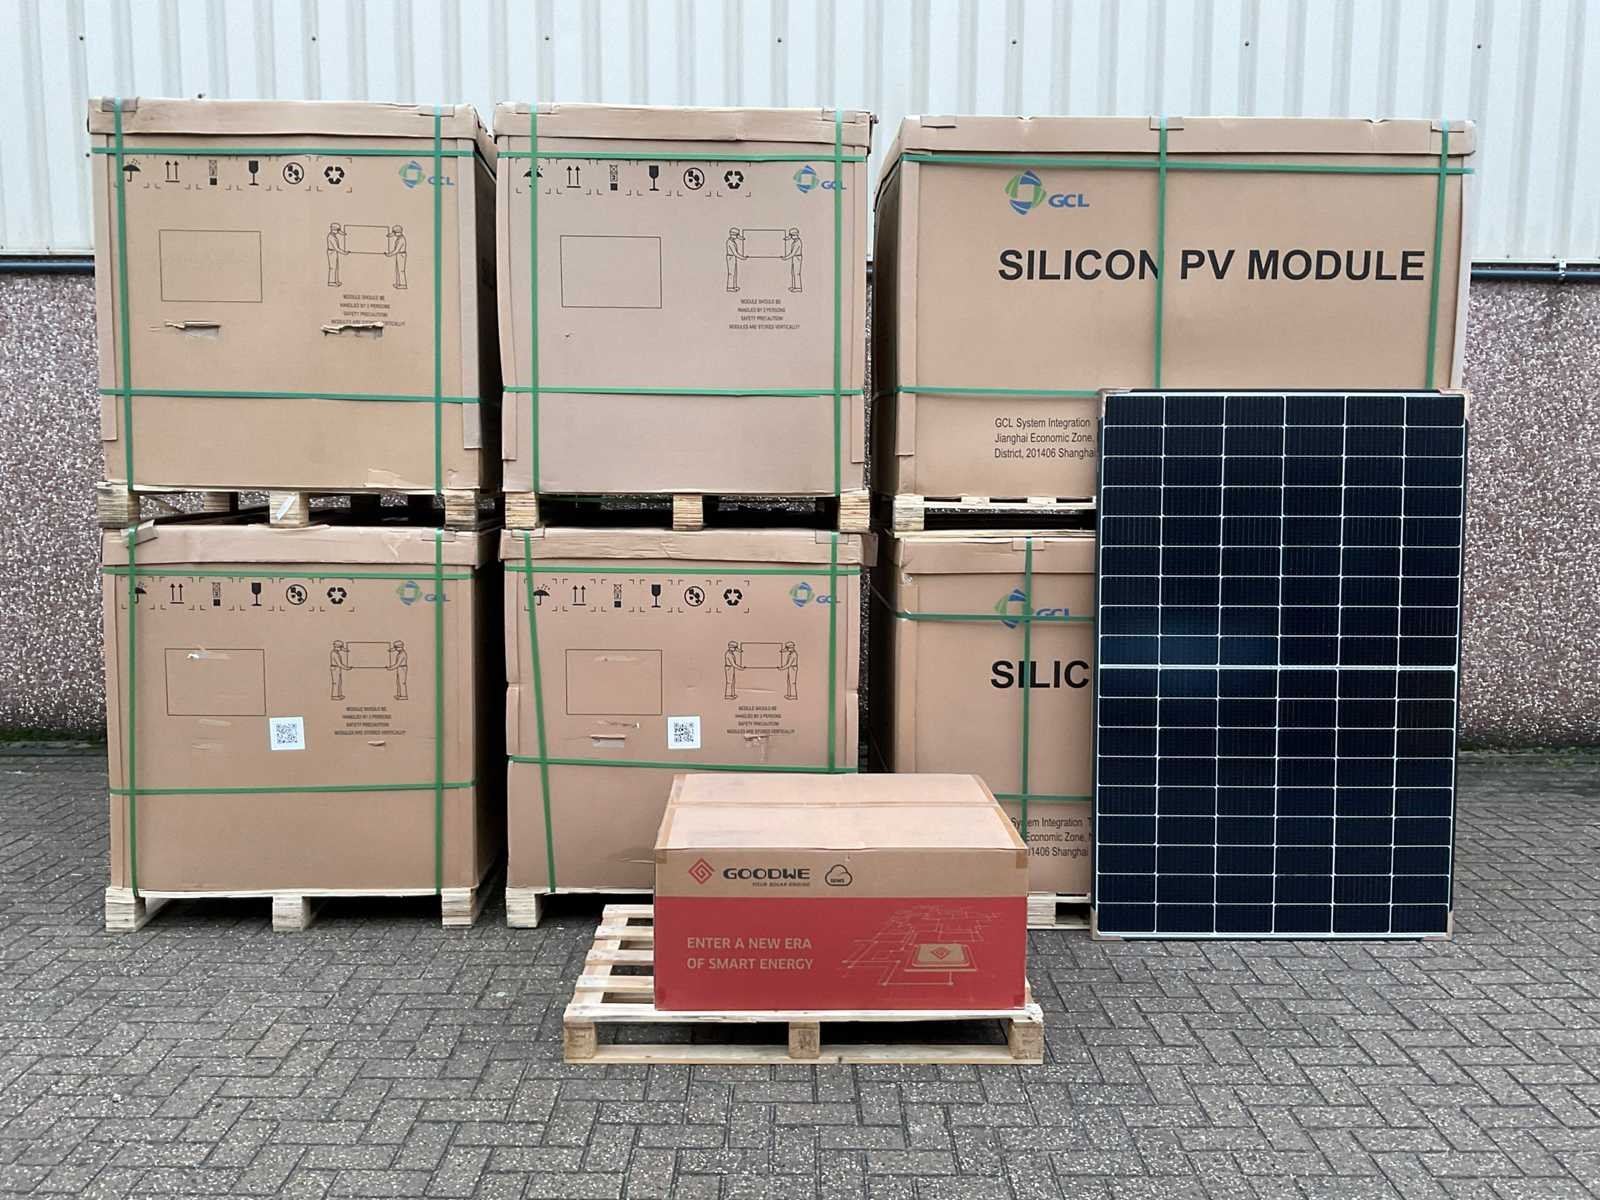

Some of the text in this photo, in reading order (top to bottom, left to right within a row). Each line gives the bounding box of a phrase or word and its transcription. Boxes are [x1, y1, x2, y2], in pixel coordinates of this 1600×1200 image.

[1048, 194, 1090, 208] GCL
[998, 249, 1425, 281] SILICON PV MODULE
[995, 417, 1090, 430] GCL System Integration
[994, 433, 1028, 445] Jianghai
[1030, 433, 1069, 443] Economic
[994, 448, 1024, 459] District,
[1026, 448, 1056, 458] 201406
[991, 660, 1089, 688] SILIC
[1011, 817, 1040, 830] Syem
[1042, 817, 1083, 829] Integration
[1052, 846, 1089, 859] Shanghai
[723, 868, 811, 880] GOODWE
[687, 937, 812, 950] ENTER A NEW ERA
[686, 957, 813, 970] OF SMART ENERGY
